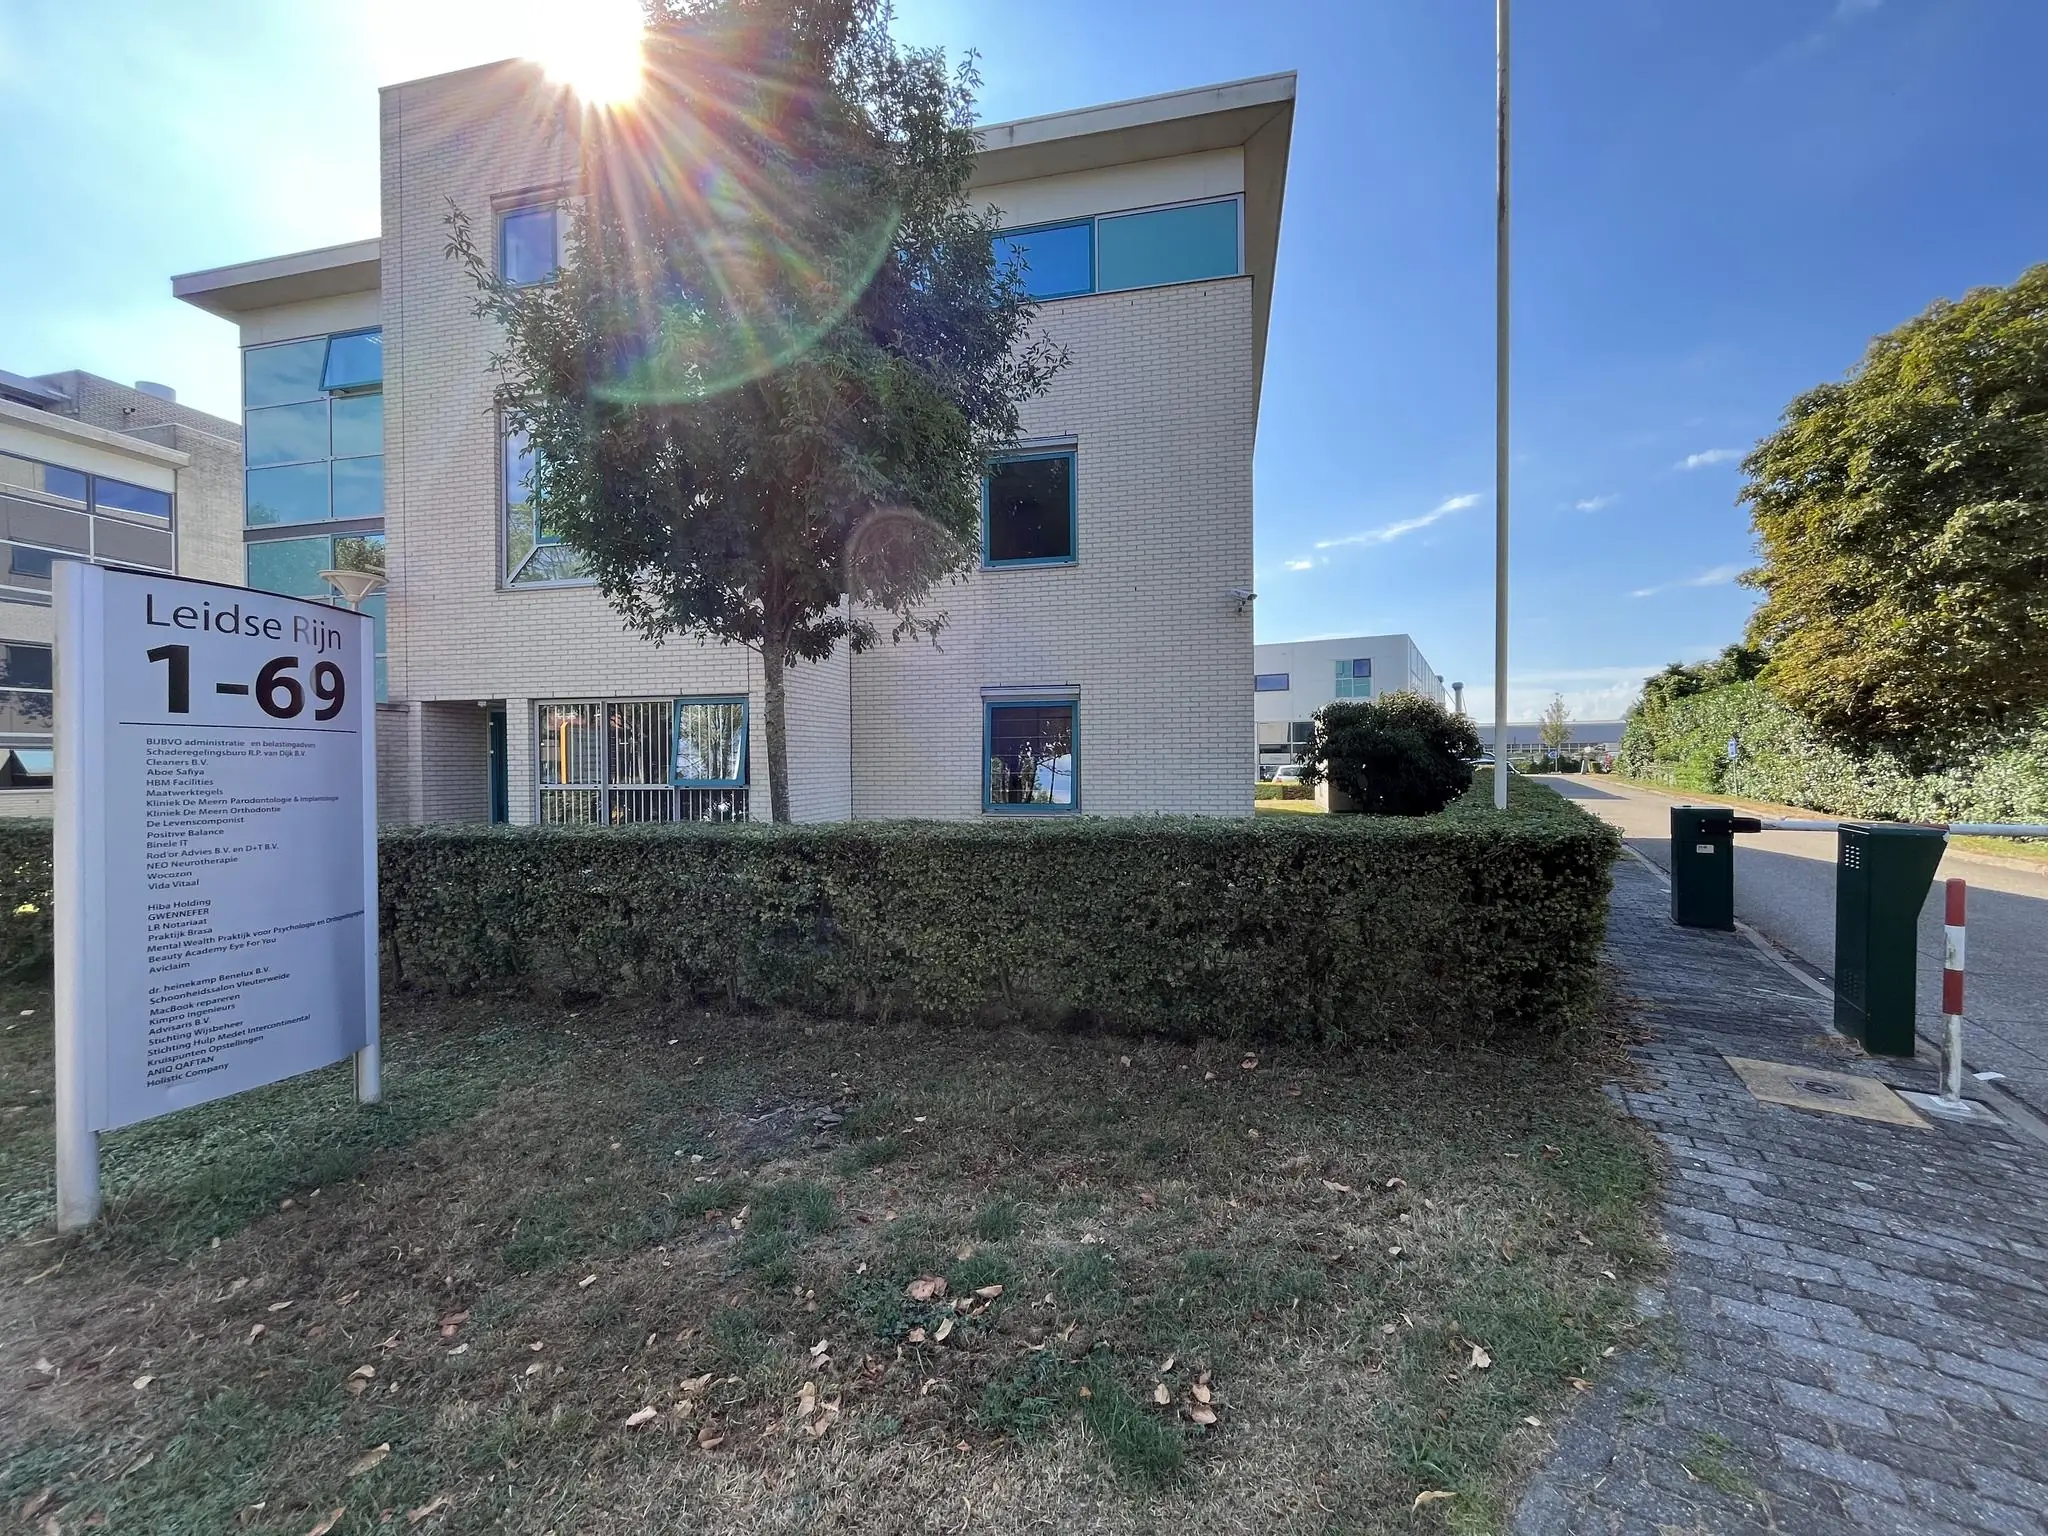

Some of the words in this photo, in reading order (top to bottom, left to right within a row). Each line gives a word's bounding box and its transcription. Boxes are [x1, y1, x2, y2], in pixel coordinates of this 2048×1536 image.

[147, 593, 282, 640] Leidse
[293, 615, 341, 654] Rijn
[184, 739, 245, 747] administratie
[146, 748, 247, 757] Schaderegelingsburo
[146, 758, 189, 766] Cleaners
[176, 768, 205, 777] Safiya
[146, 779, 171, 787] HBM
[173, 778, 214, 786] Facilities
[146, 788, 224, 797] Maatwerktegels
[146, 809, 181, 817] Kliniek
[146, 820, 161, 828] De
[163, 817, 245, 826] Levenscomponist
[147, 831, 186, 839] Positive
[188, 829, 225, 837] Balance
[181, 849, 213, 857] Advies
[146, 862, 169, 870] NEO
[171, 857, 239, 867] Neurotherapie
[148, 882, 171, 890] Vida
[172, 879, 200, 888] Vitaal
[173, 899, 212, 909] Holding
[147, 908, 210, 921] GWENNEFER
[147, 923, 161, 932] LR
[162, 918, 208, 930] Notariaat
[147, 942, 181, 953] Mental
[183, 937, 216, 947] Wealth
[217, 931, 251, 942] Praktijk
[253, 929, 272, 937] voor
[148, 931, 185, 942] Praktijk
[187, 928, 213, 936] Brasa
[148, 952, 183, 963] Beauty
[185, 944, 228, 957] Academy
[229, 942, 245, 951] Eye
[246, 939, 262, 947] For
[262, 937, 277, 945] You
[149, 962, 191, 974] Aviclaim
[163, 977, 217, 992] heinekamp
[219, 970, 254, 982] Benelux
[149, 984, 235, 1005] Schoonheidssalon
[236, 973, 291, 988] Vleuterweide
[149, 1002, 194, 1016] MacBook
[196, 994, 241, 1006] repareren
[149, 1014, 185, 1026] Kimpro
[187, 1003, 236, 1018] Ingenieurs
[147, 1041, 191, 1057] Stichting
[193, 1036, 216, 1046] Hulp
[217, 1029, 246, 1041] Medet
[247, 1013, 311, 1034] Intercontinental
[148, 1022, 192, 1036] Advisaris
[148, 1031, 192, 1046] Stichting
[193, 1021, 244, 1036] Wijsbeheer
[147, 1049, 207, 1067] Kruispunten
[208, 1035, 264, 1053] Opstellingen
[146, 1065, 173, 1078] ANIQ
[175, 1055, 215, 1070] QAFTAN
[146, 1073, 184, 1088] Holistic
[185, 1063, 229, 1078] Company
